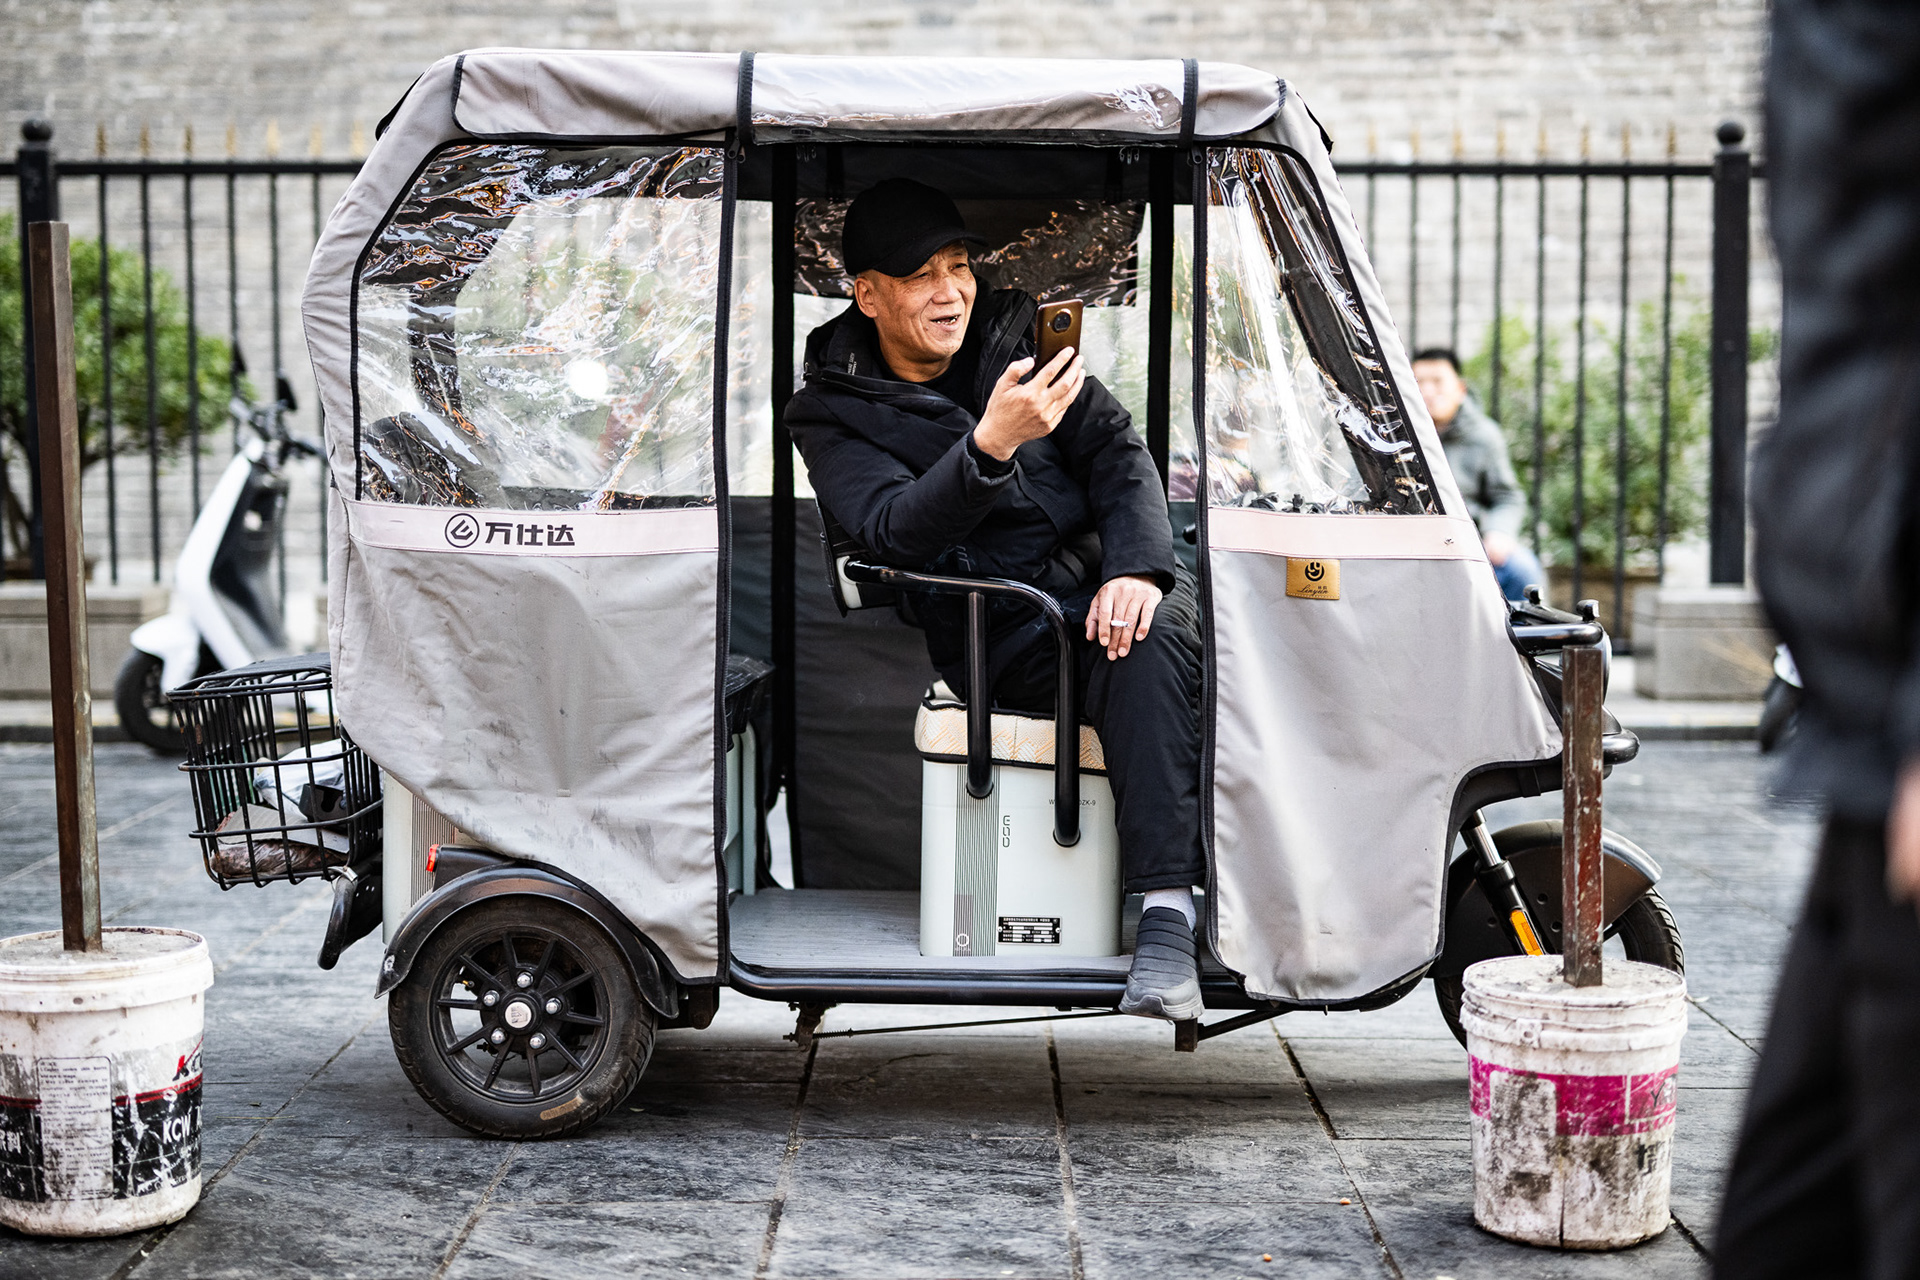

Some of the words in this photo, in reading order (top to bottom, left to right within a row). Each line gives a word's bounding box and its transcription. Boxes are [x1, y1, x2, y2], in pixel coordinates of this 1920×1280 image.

[484, 521, 576, 547] 万仕达
[162, 1114, 191, 1145] KCW
